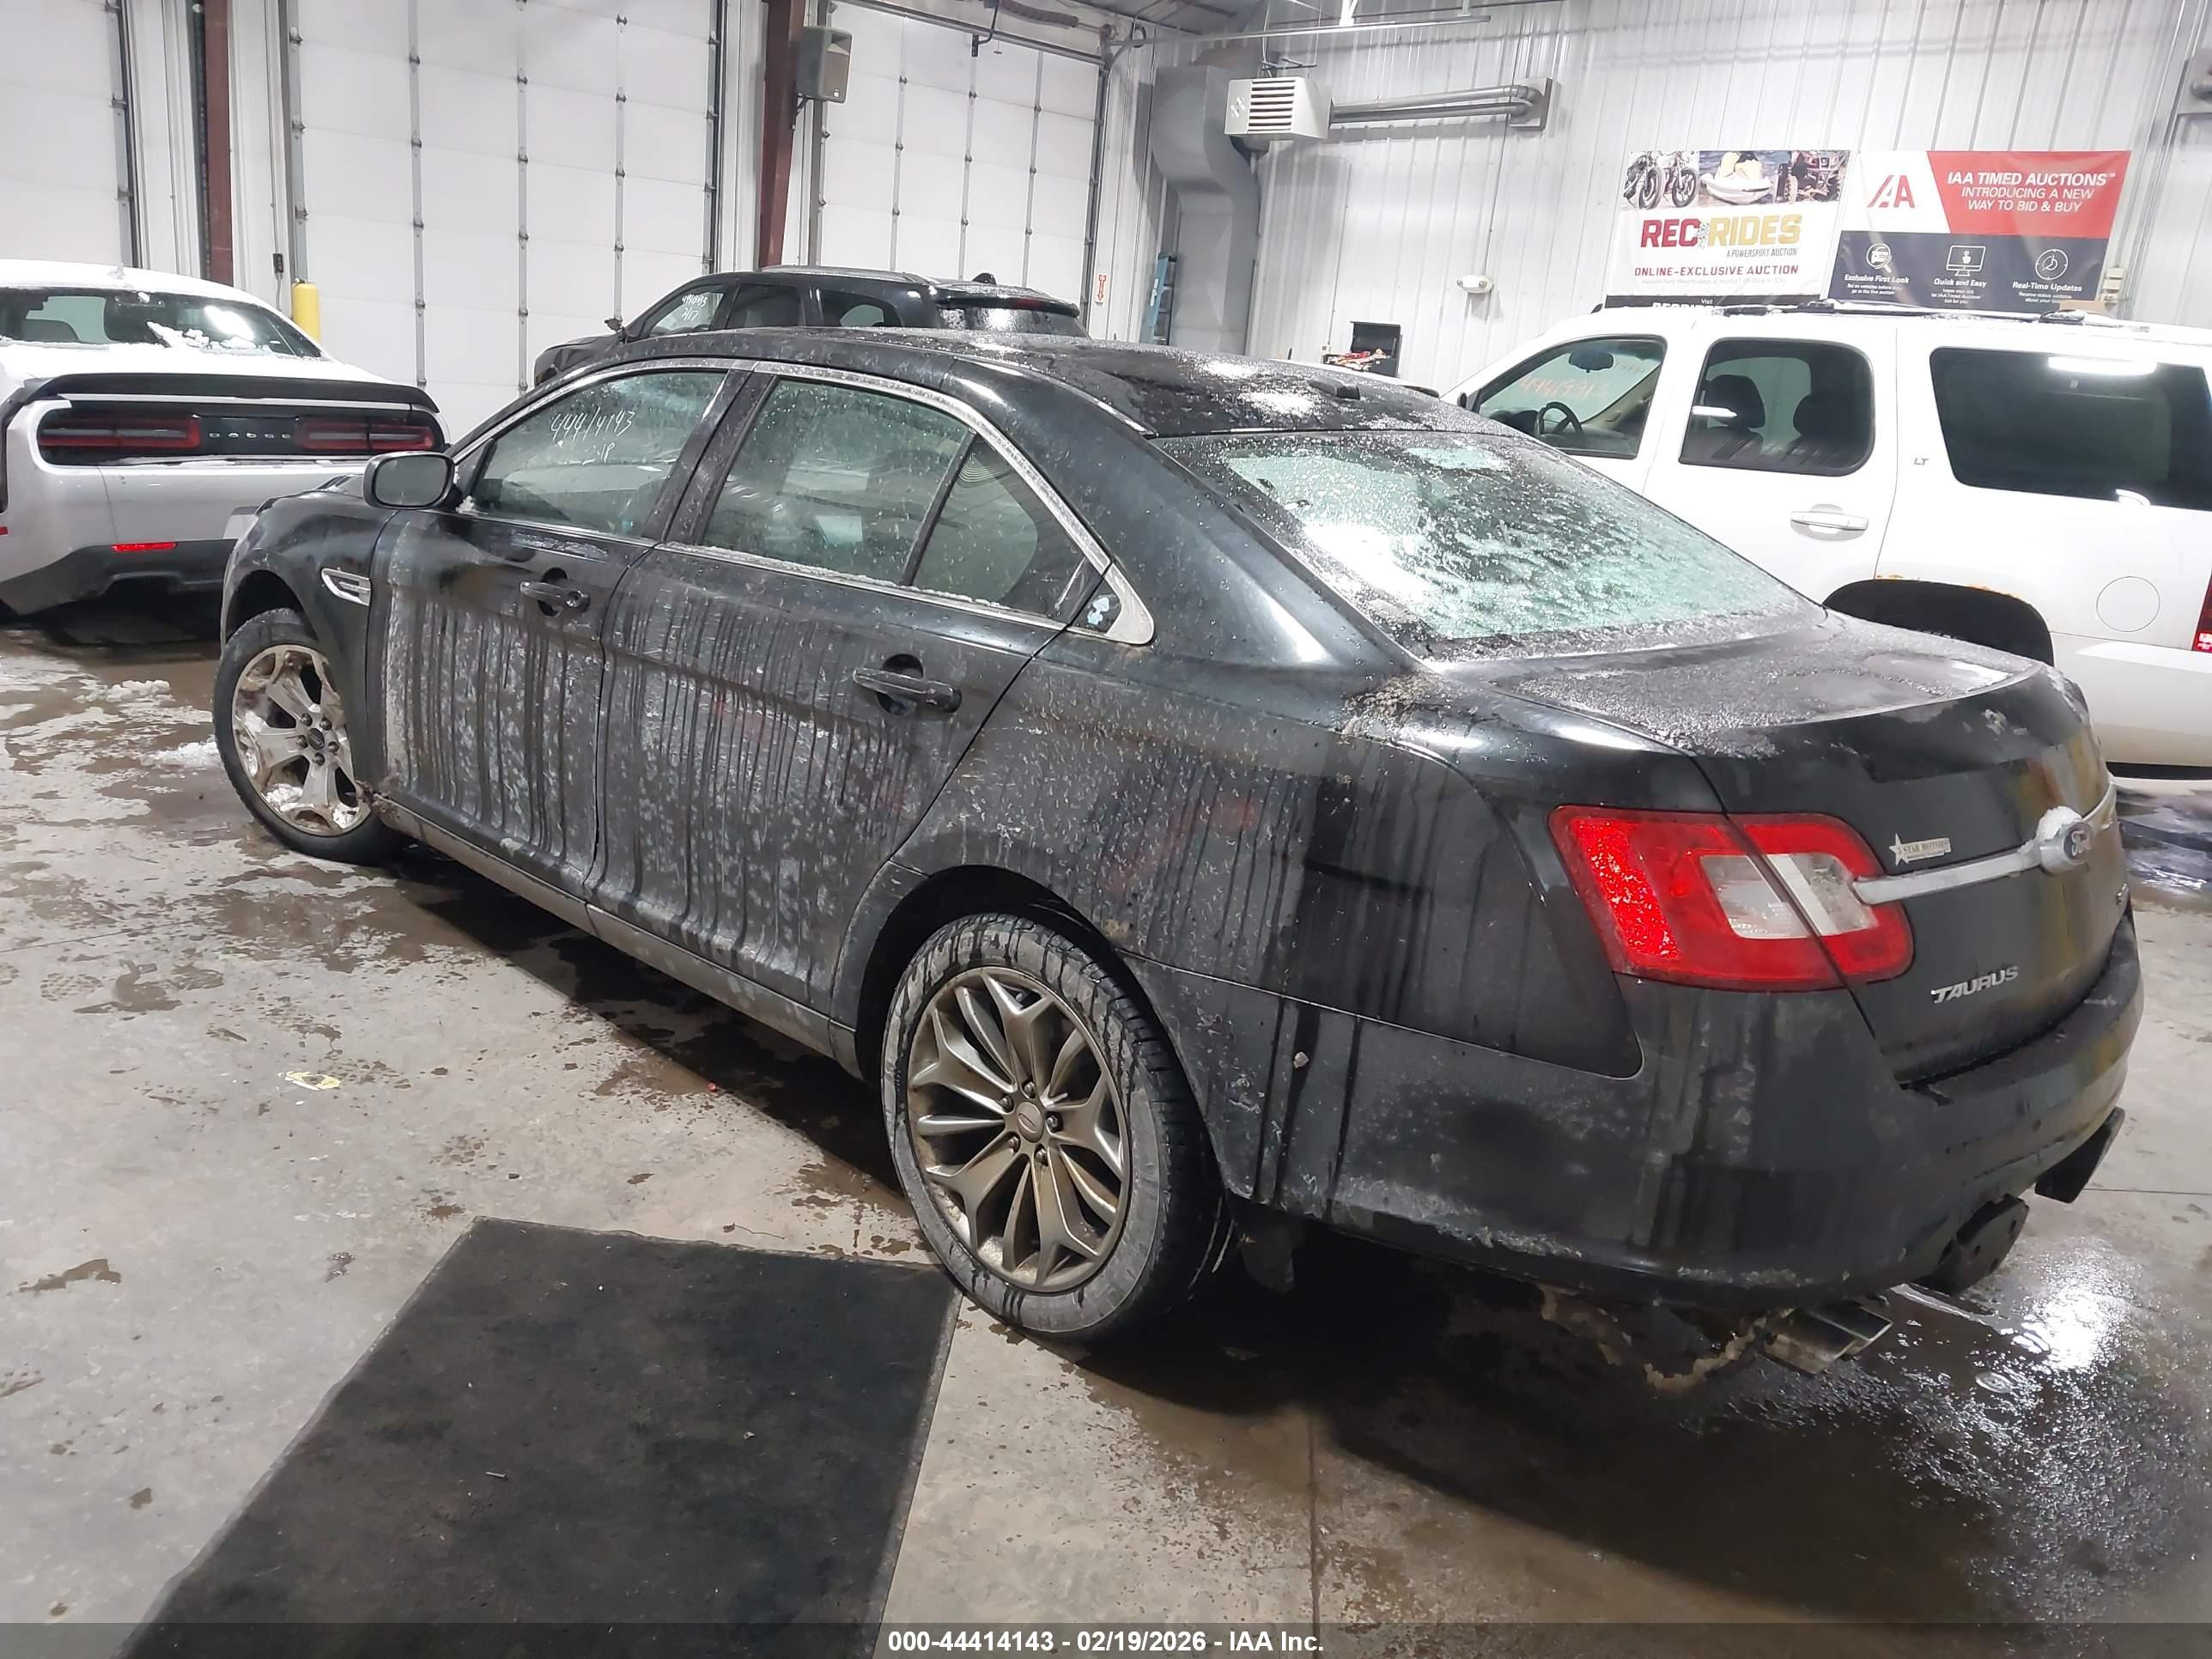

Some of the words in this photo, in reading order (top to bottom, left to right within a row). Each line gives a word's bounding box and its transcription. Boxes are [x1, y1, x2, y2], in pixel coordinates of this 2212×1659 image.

[1948, 172, 1973, 185] IAA
[1978, 172, 2022, 185] TIMED
[1961, 186, 2046, 198] INTRODUCING
[2049, 188, 2058, 198] A
[2063, 188, 2095, 199] NEW
[1967, 200, 1995, 210] WAY
[1997, 200, 2014, 211] TO
[2017, 201, 2038, 211] BID
[2040, 201, 2051, 212] &
[2054, 201, 2082, 212] BUY
[1641, 218, 1701, 247] REC
[1708, 214, 1802, 247] RIDES
[1732, 248, 1770, 258] POWERSPORT
[1771, 247, 1797, 258] AUCTION
[1635, 265, 1743, 276] ONLINE-EXCLUSIVE
[1747, 264, 1799, 276] AUCTION
[1844, 274, 1874, 283] Exclusive
[1970, 279, 1988, 288] Easy
[2051, 283, 2082, 292] Updates
[1914, 457, 1929, 466] LT
[1931, 966, 2019, 1003] TAURUS
